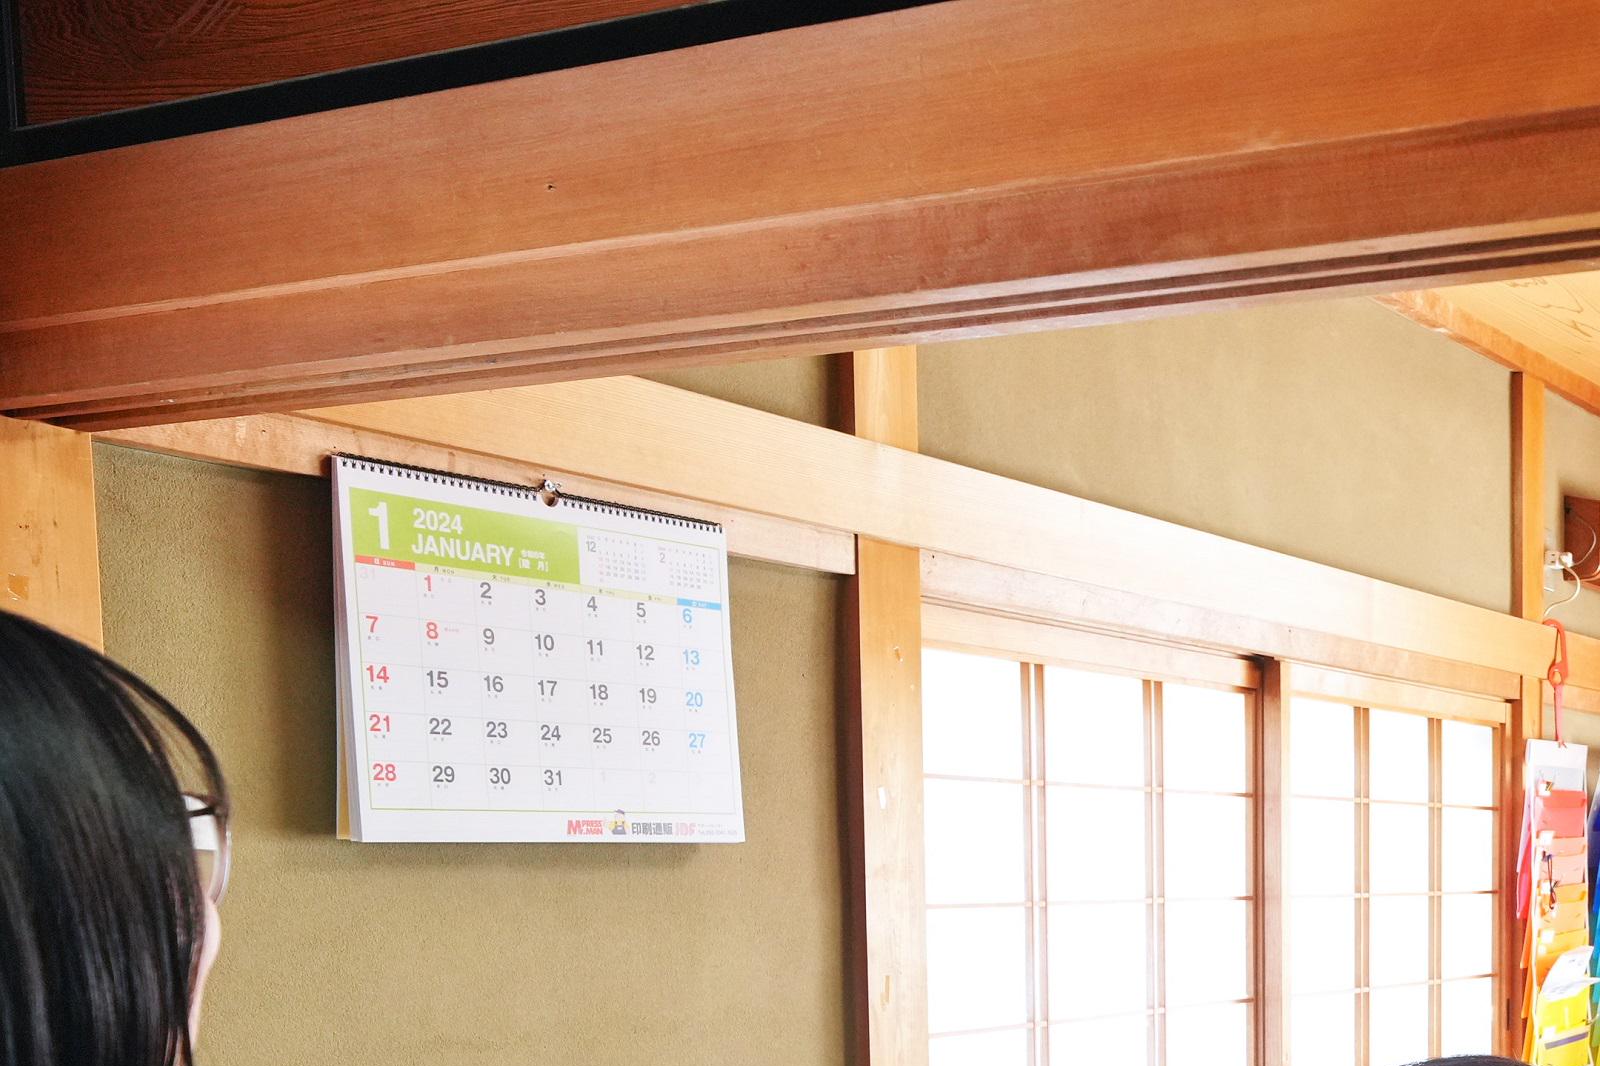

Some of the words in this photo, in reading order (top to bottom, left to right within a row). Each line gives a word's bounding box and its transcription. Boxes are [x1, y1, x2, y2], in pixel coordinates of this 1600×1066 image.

[368, 501, 390, 550] 1
[412, 508, 463, 534] 2024
[411, 533, 514, 567] JANUARY
[424, 575, 432, 592] 1
[480, 582, 492, 599] 2
[535, 589, 547, 606] 3
[586, 596, 598, 612] 4
[636, 602, 647, 618] 5
[682, 608, 693, 623] 6
[366, 615, 379, 633] 7
[426, 622, 439, 640] 8
[483, 628, 495, 645] 9
[535, 634, 555, 651] 10
[586, 640, 603, 656] 11
[636, 645, 655, 661] 12
[682, 649, 700, 665] 13
[366, 665, 390, 683] 14
[427, 671, 449, 688] 15
[484, 675, 504, 693] 16
[537, 680, 557, 696] 17
[590, 684, 608, 700] 18
[639, 688, 657, 704] 19
[685, 691, 703, 707] 20
[369, 714, 391, 732] 21
[429, 718, 452, 735] 22
[486, 721, 508, 738] 23
[540, 724, 561, 741] 24
[592, 727, 612, 744] 25
[641, 730, 661, 746] 26
[688, 733, 706, 748] 27
[372, 763, 397, 781] 28
[432, 765, 455, 783] 29
[489, 768, 511, 785] 30
[543, 769, 563, 786] 31
